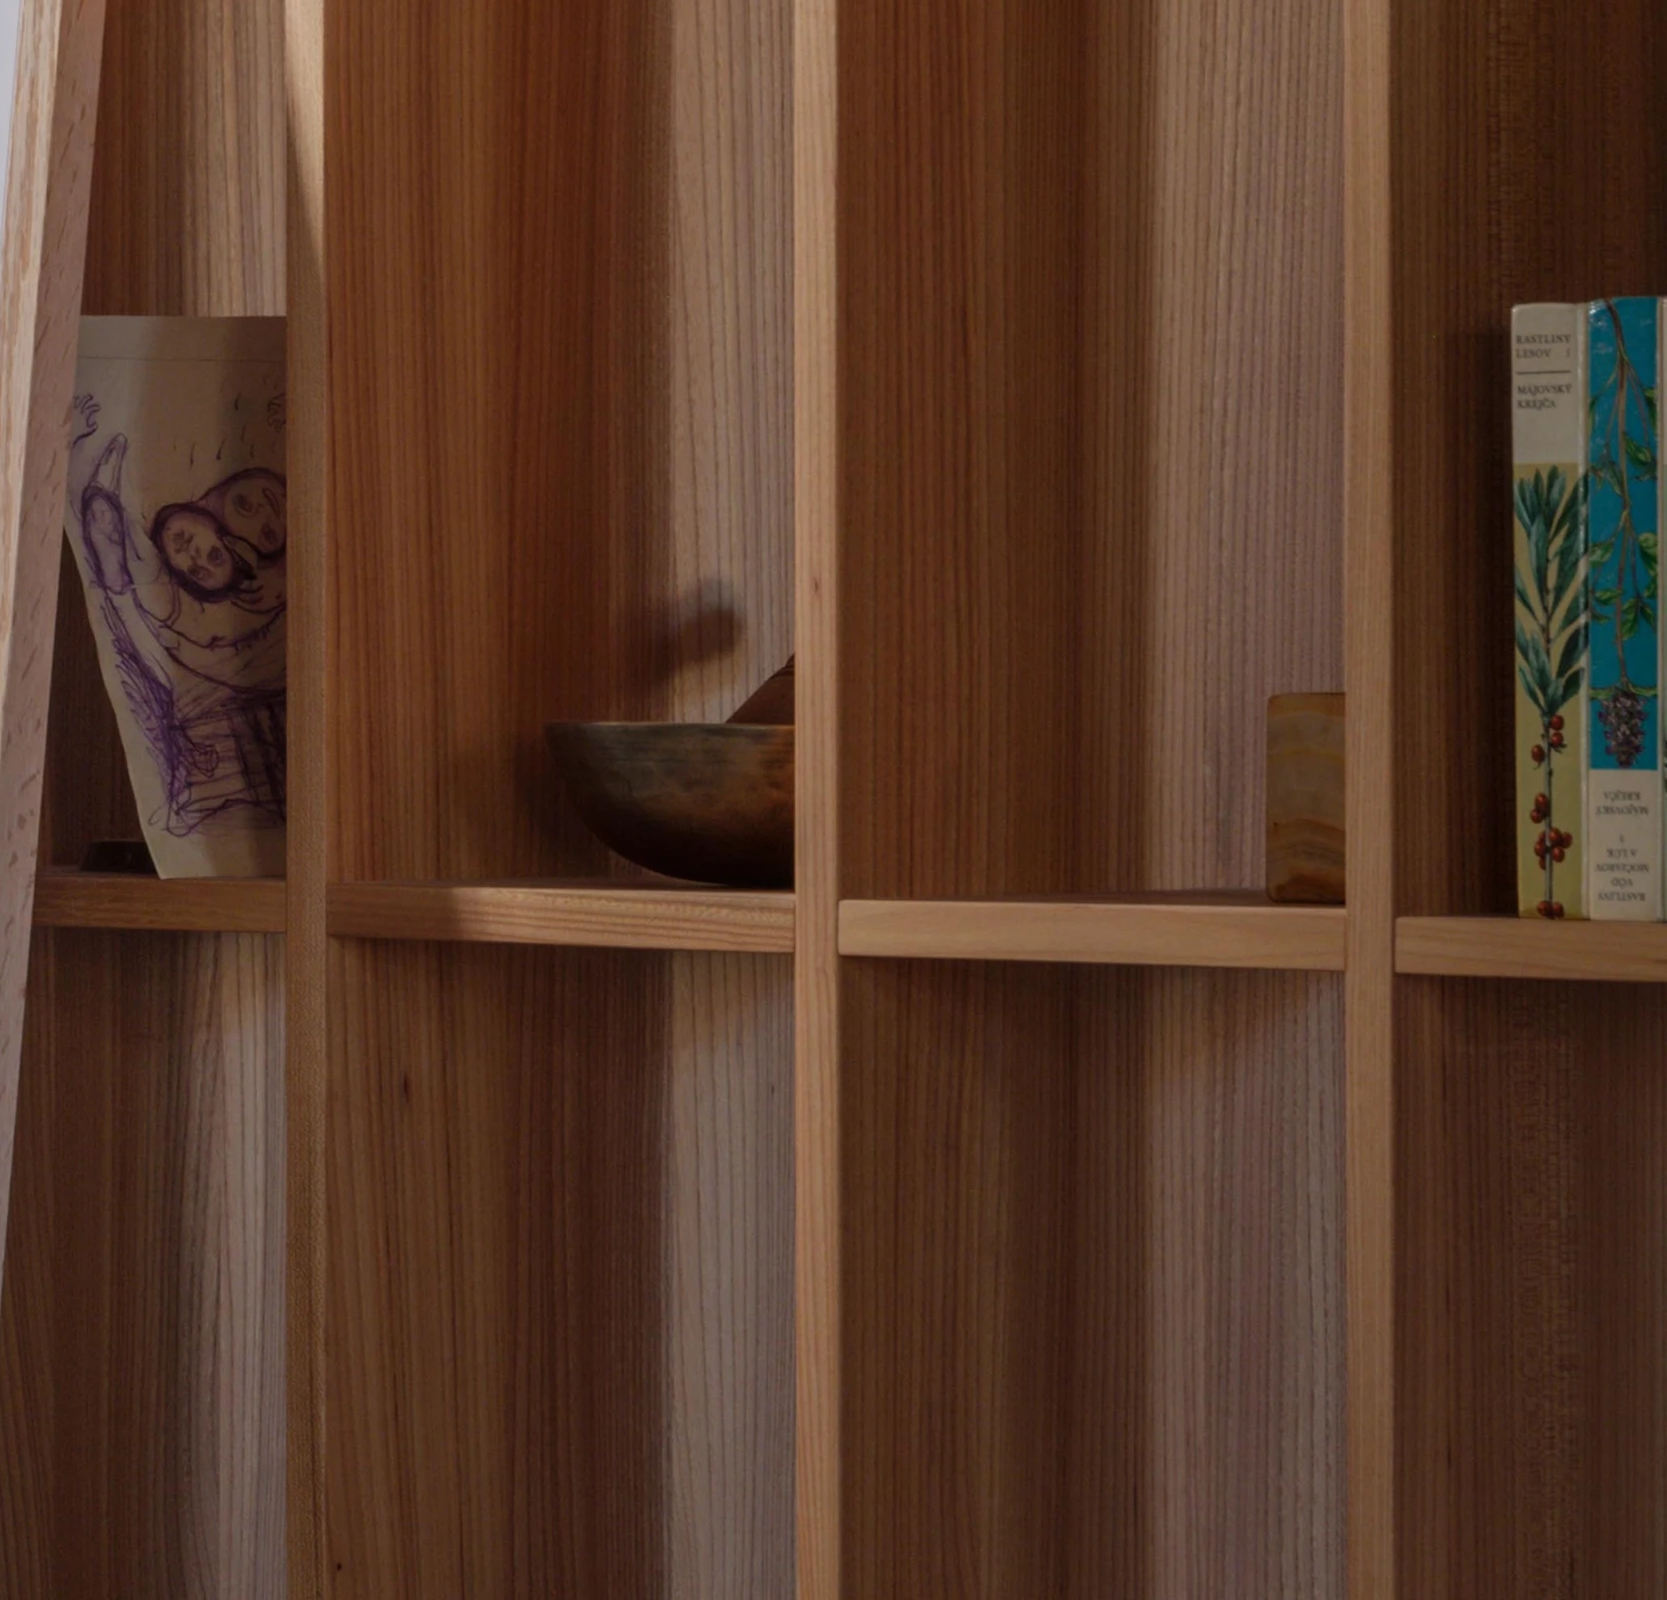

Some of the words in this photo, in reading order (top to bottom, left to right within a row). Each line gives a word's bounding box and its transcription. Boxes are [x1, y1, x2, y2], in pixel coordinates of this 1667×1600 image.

[1515, 334, 1572, 345] RASTLINY
[1515, 348, 1552, 359] LESOV
[1517, 397, 1557, 411] KREJČA
[1603, 789, 1641, 802] KREJČA
[1598, 891, 1646, 902] RASTLINY
